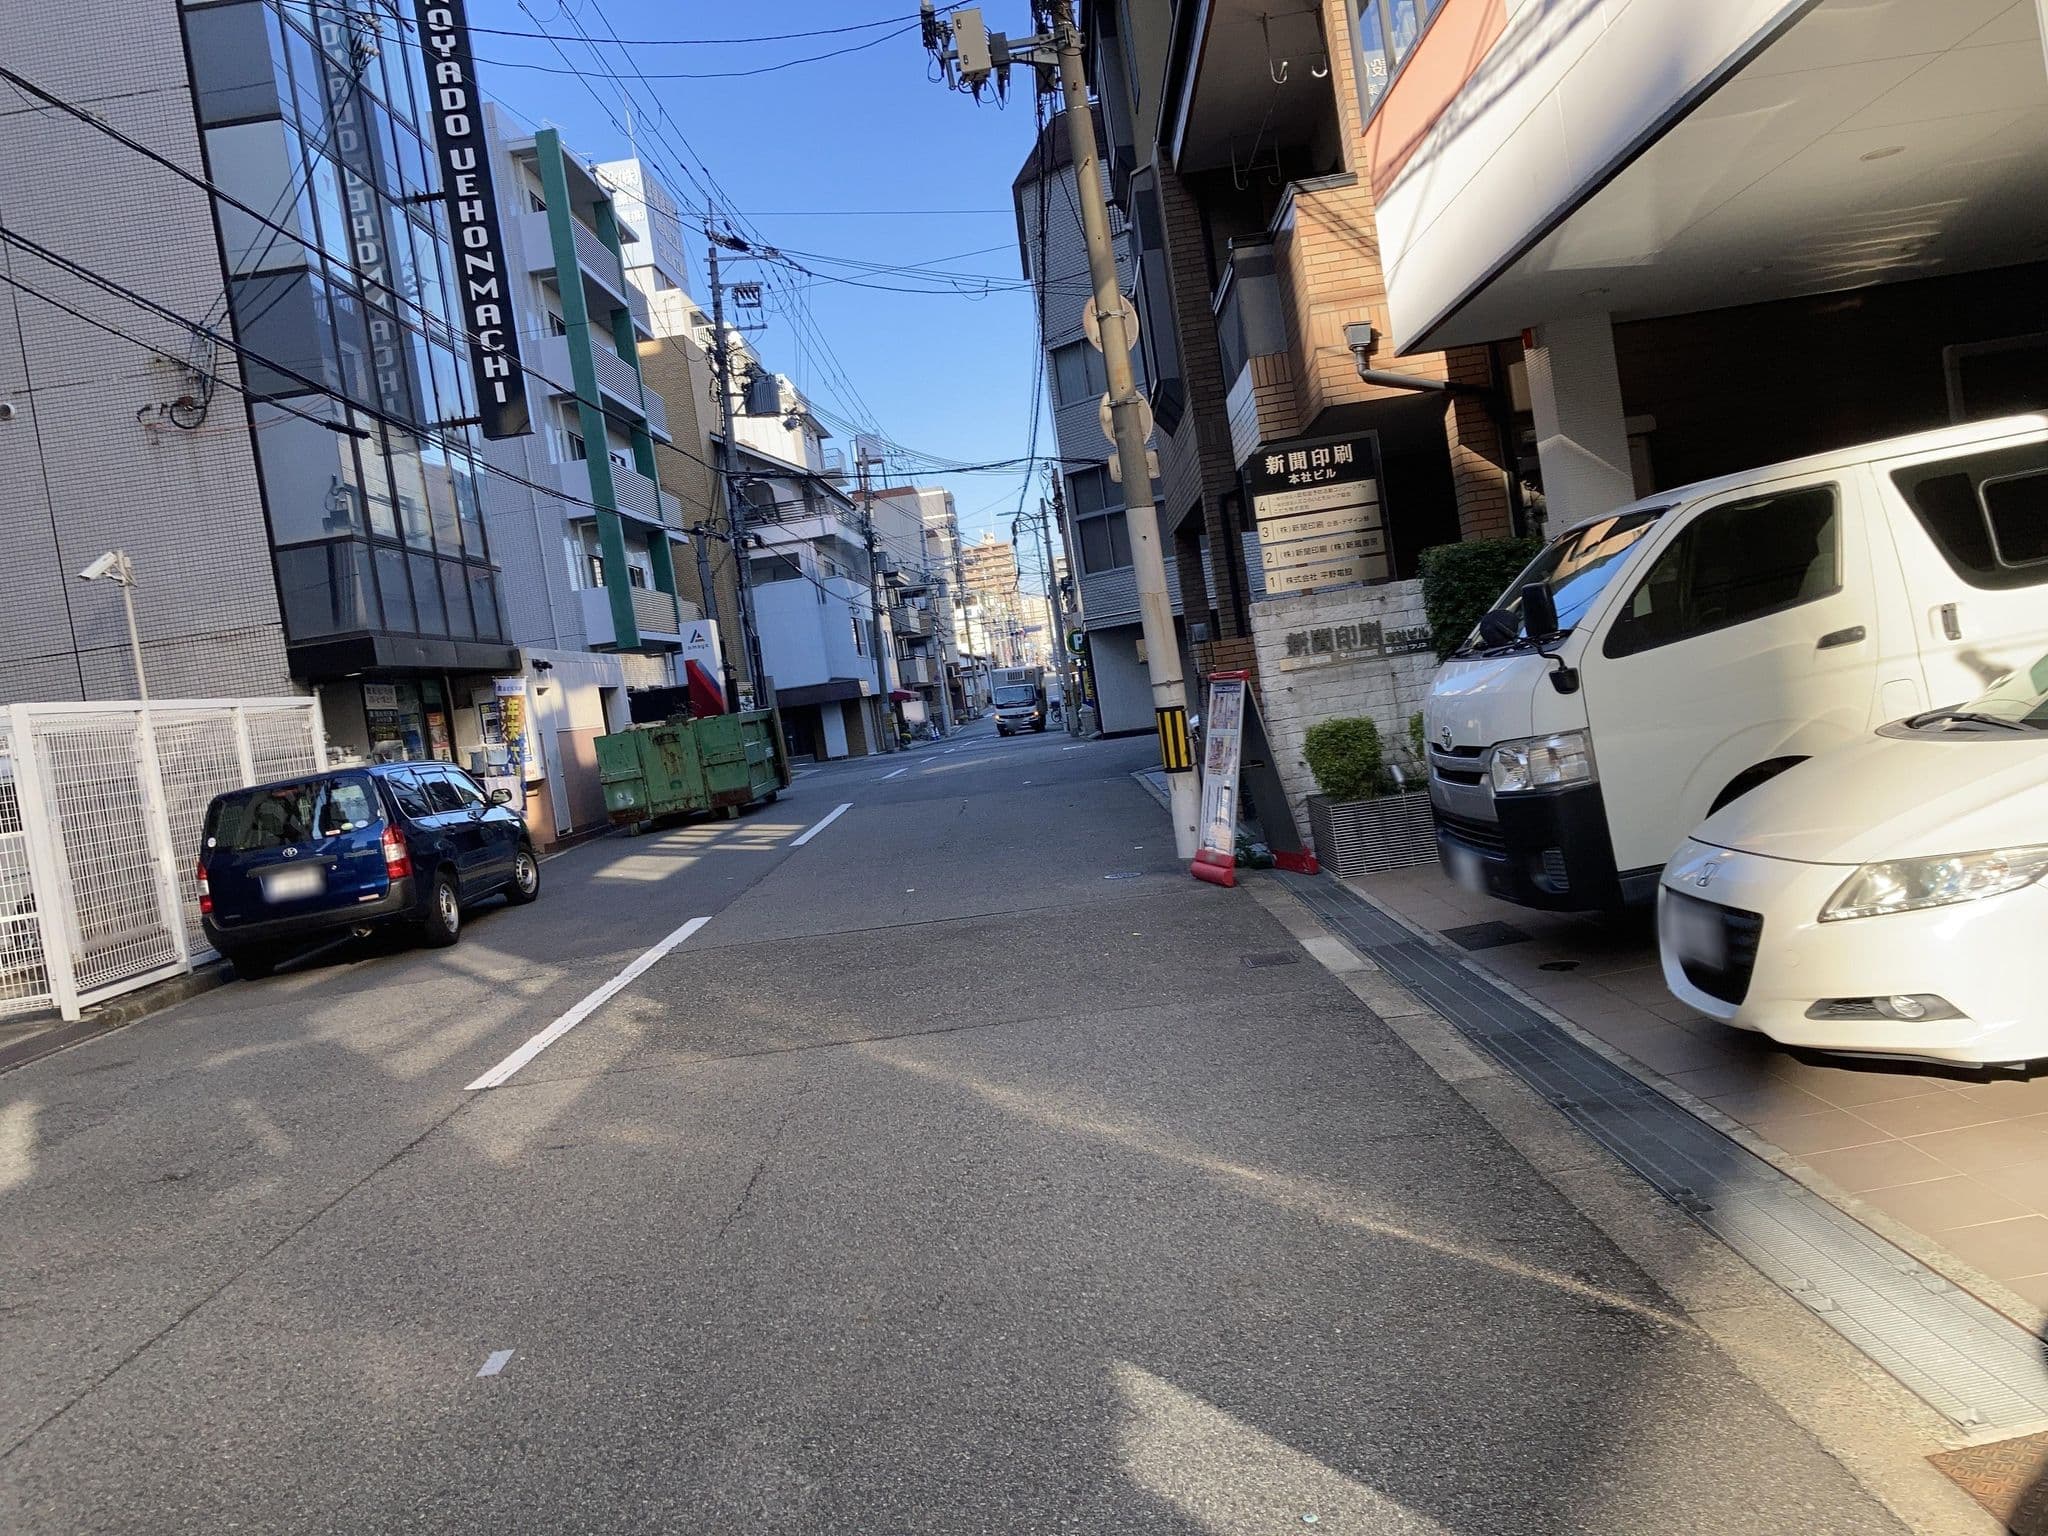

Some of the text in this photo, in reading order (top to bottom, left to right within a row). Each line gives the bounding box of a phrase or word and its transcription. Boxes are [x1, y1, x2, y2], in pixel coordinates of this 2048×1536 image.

[425, 0, 510, 403] OYADO UEHONMACHI
[1265, 443, 1353, 475] 新聞印刷
[1288, 468, 1337, 485] 本社ビル
[1258, 501, 1266, 512] 4
[1262, 527, 1269, 538] 3
[1266, 552, 1273, 563] 2
[1270, 577, 1276, 588] 1
[1285, 574, 1318, 585] 株式会社
[1073, 633, 1084, 650] P
